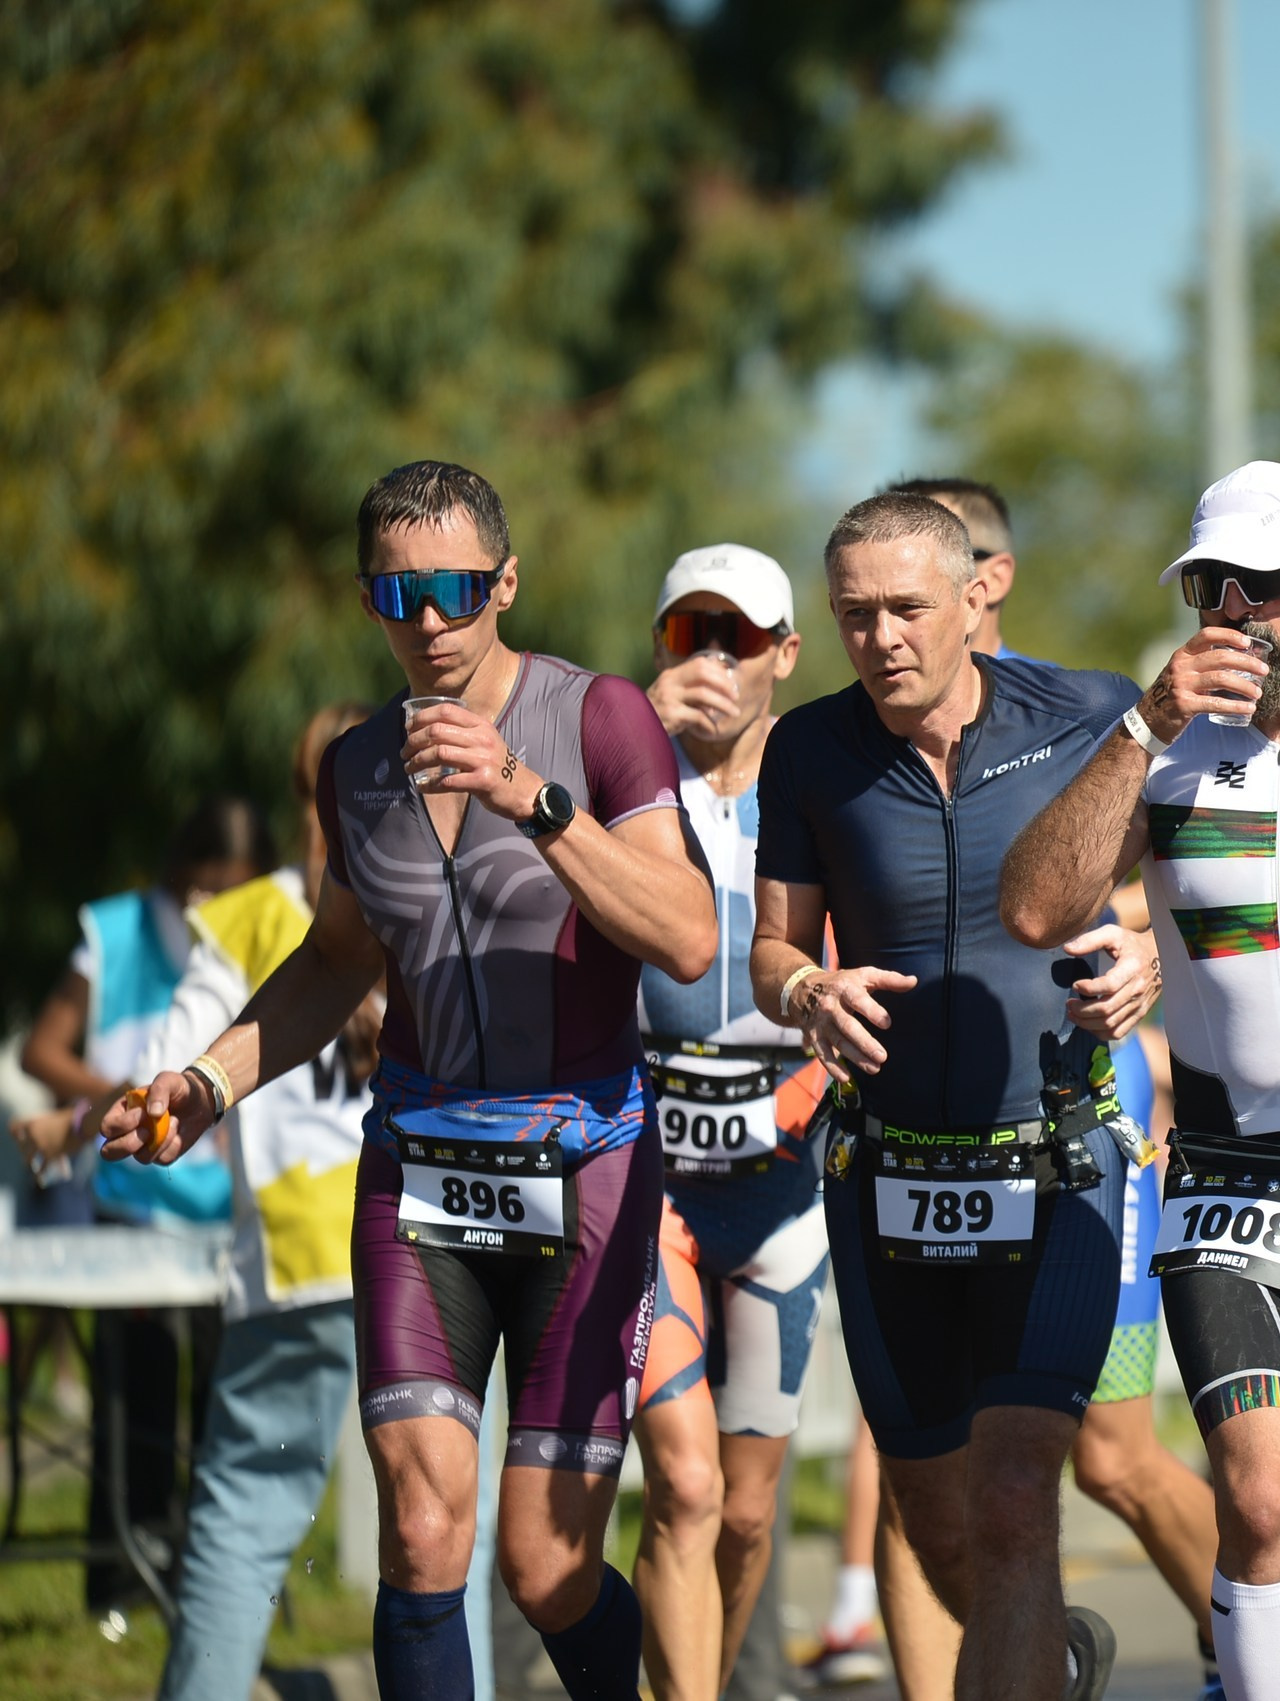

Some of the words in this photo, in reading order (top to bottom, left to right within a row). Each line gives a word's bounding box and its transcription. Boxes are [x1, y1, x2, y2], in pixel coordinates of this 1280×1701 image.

[982, 744, 1052, 779] IronTRI
[664, 1108, 746, 1152] 900
[1180, 1179, 1196, 1189] STAR
[441, 1176, 526, 1223] 896
[908, 1188, 994, 1234] 789
[463, 1229, 504, 1246] АНТОН
[540, 1246, 555, 1257] 113
[922, 1242, 978, 1258] ВИТАЛИЙ
[1008, 1252, 1021, 1262] 113
[1196, 1251, 1249, 1269] ДАНИЕЛ
[629, 1236, 655, 1367] ГАЗПРОМБАНК
